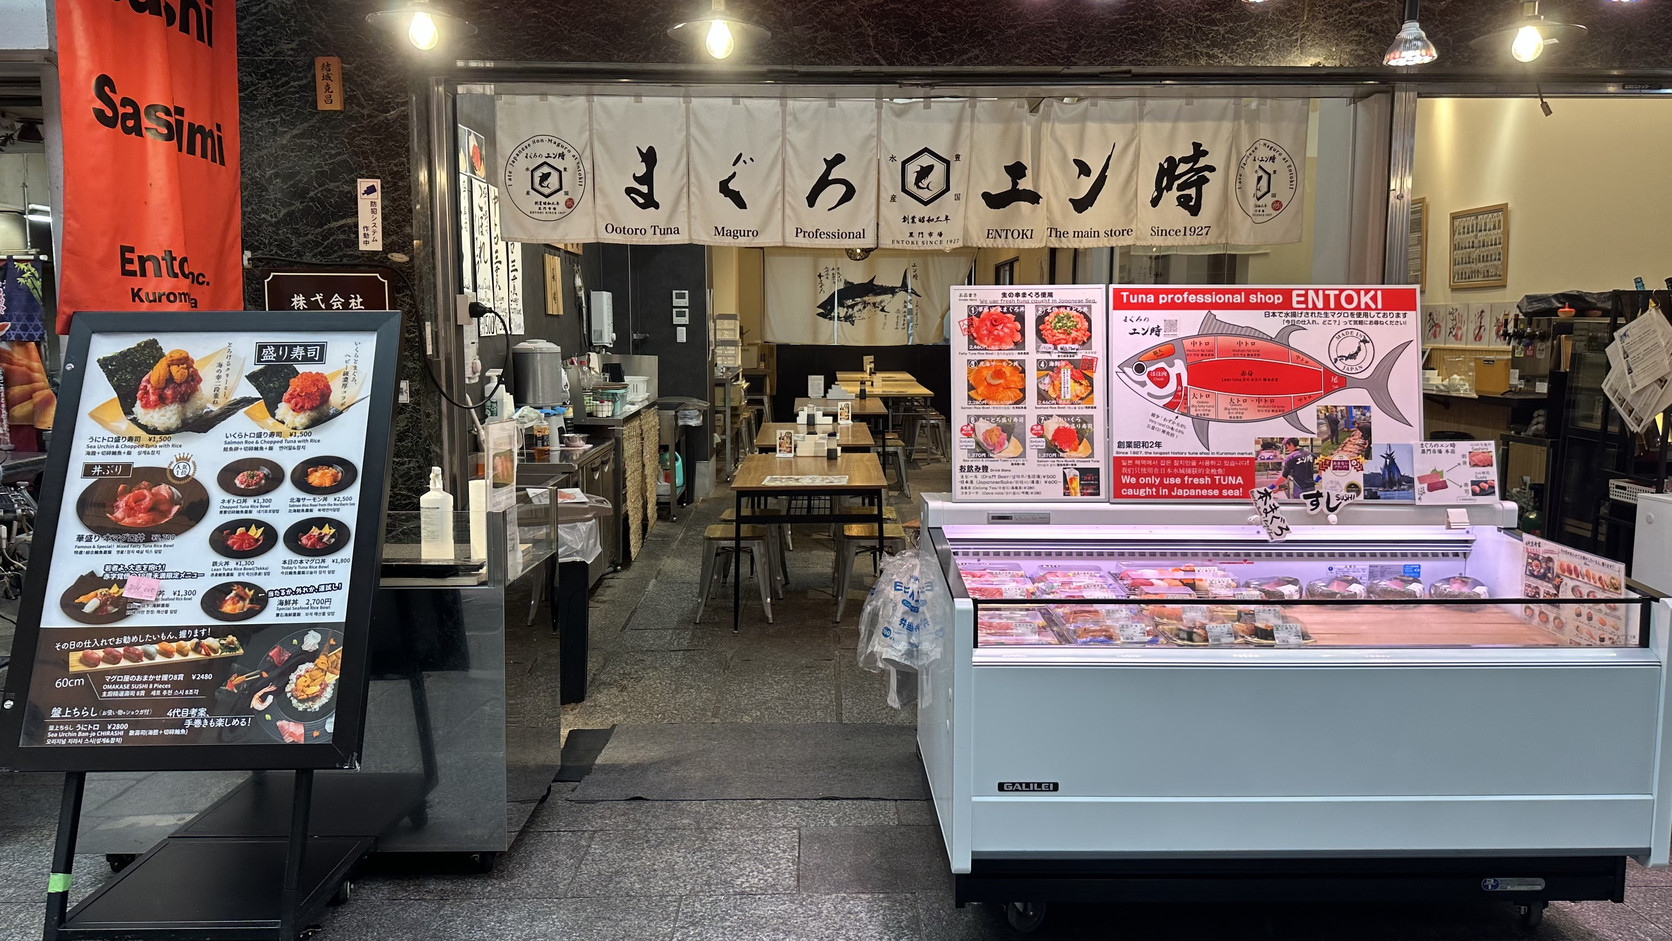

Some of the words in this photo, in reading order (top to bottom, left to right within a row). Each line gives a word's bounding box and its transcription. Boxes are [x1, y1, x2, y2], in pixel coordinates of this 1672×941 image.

[320, 61, 334, 105] 結城克昌
[92, 73, 226, 166] Sasimi
[370, 200, 378, 243] 防犯システム
[604, 222, 647, 236] Ootoro
[650, 223, 680, 235] Tuna
[714, 226, 759, 240] Maguro
[795, 226, 866, 240] Professional
[986, 228, 1034, 240] ENTOKI
[1047, 226, 1069, 238] The
[1072, 227, 1100, 238] main
[1103, 226, 1134, 238] store
[1150, 225, 1211, 237] Since1927
[362, 225, 370, 246] 作動中
[1120, 292, 1154, 304] Tuna
[1159, 291, 1244, 304] professional
[1249, 292, 1283, 304] shop
[1292, 290, 1382, 309] ENTOKI
[1128, 325, 1162, 337] エン時
[1336, 331, 1354, 340] MADE
[260, 345, 320, 361] 盛り寿司
[91, 465, 122, 476] 丼ぶり
[1121, 476, 1136, 484] We
[1138, 476, 1160, 486] only
[1184, 476, 1211, 484] fresh
[1214, 476, 1244, 484] TUNA
[1121, 488, 1156, 497] caught
[1171, 488, 1219, 496] Japanese
[1303, 490, 1342, 512] すし
[1257, 488, 1290, 536] 本まぐろ
[55, 627, 211, 650] その日の仕入れでお勧めしたいもん、握ります!
[55, 678, 84, 688] 60cm
[105, 673, 184, 682] マグロ屋のおまかせ握り8貫
[50, 707, 97, 718] 盤上ちらし
[167, 708, 210, 718] 4代目考案、
[184, 718, 251, 728] 手巻きも楽しめる!
